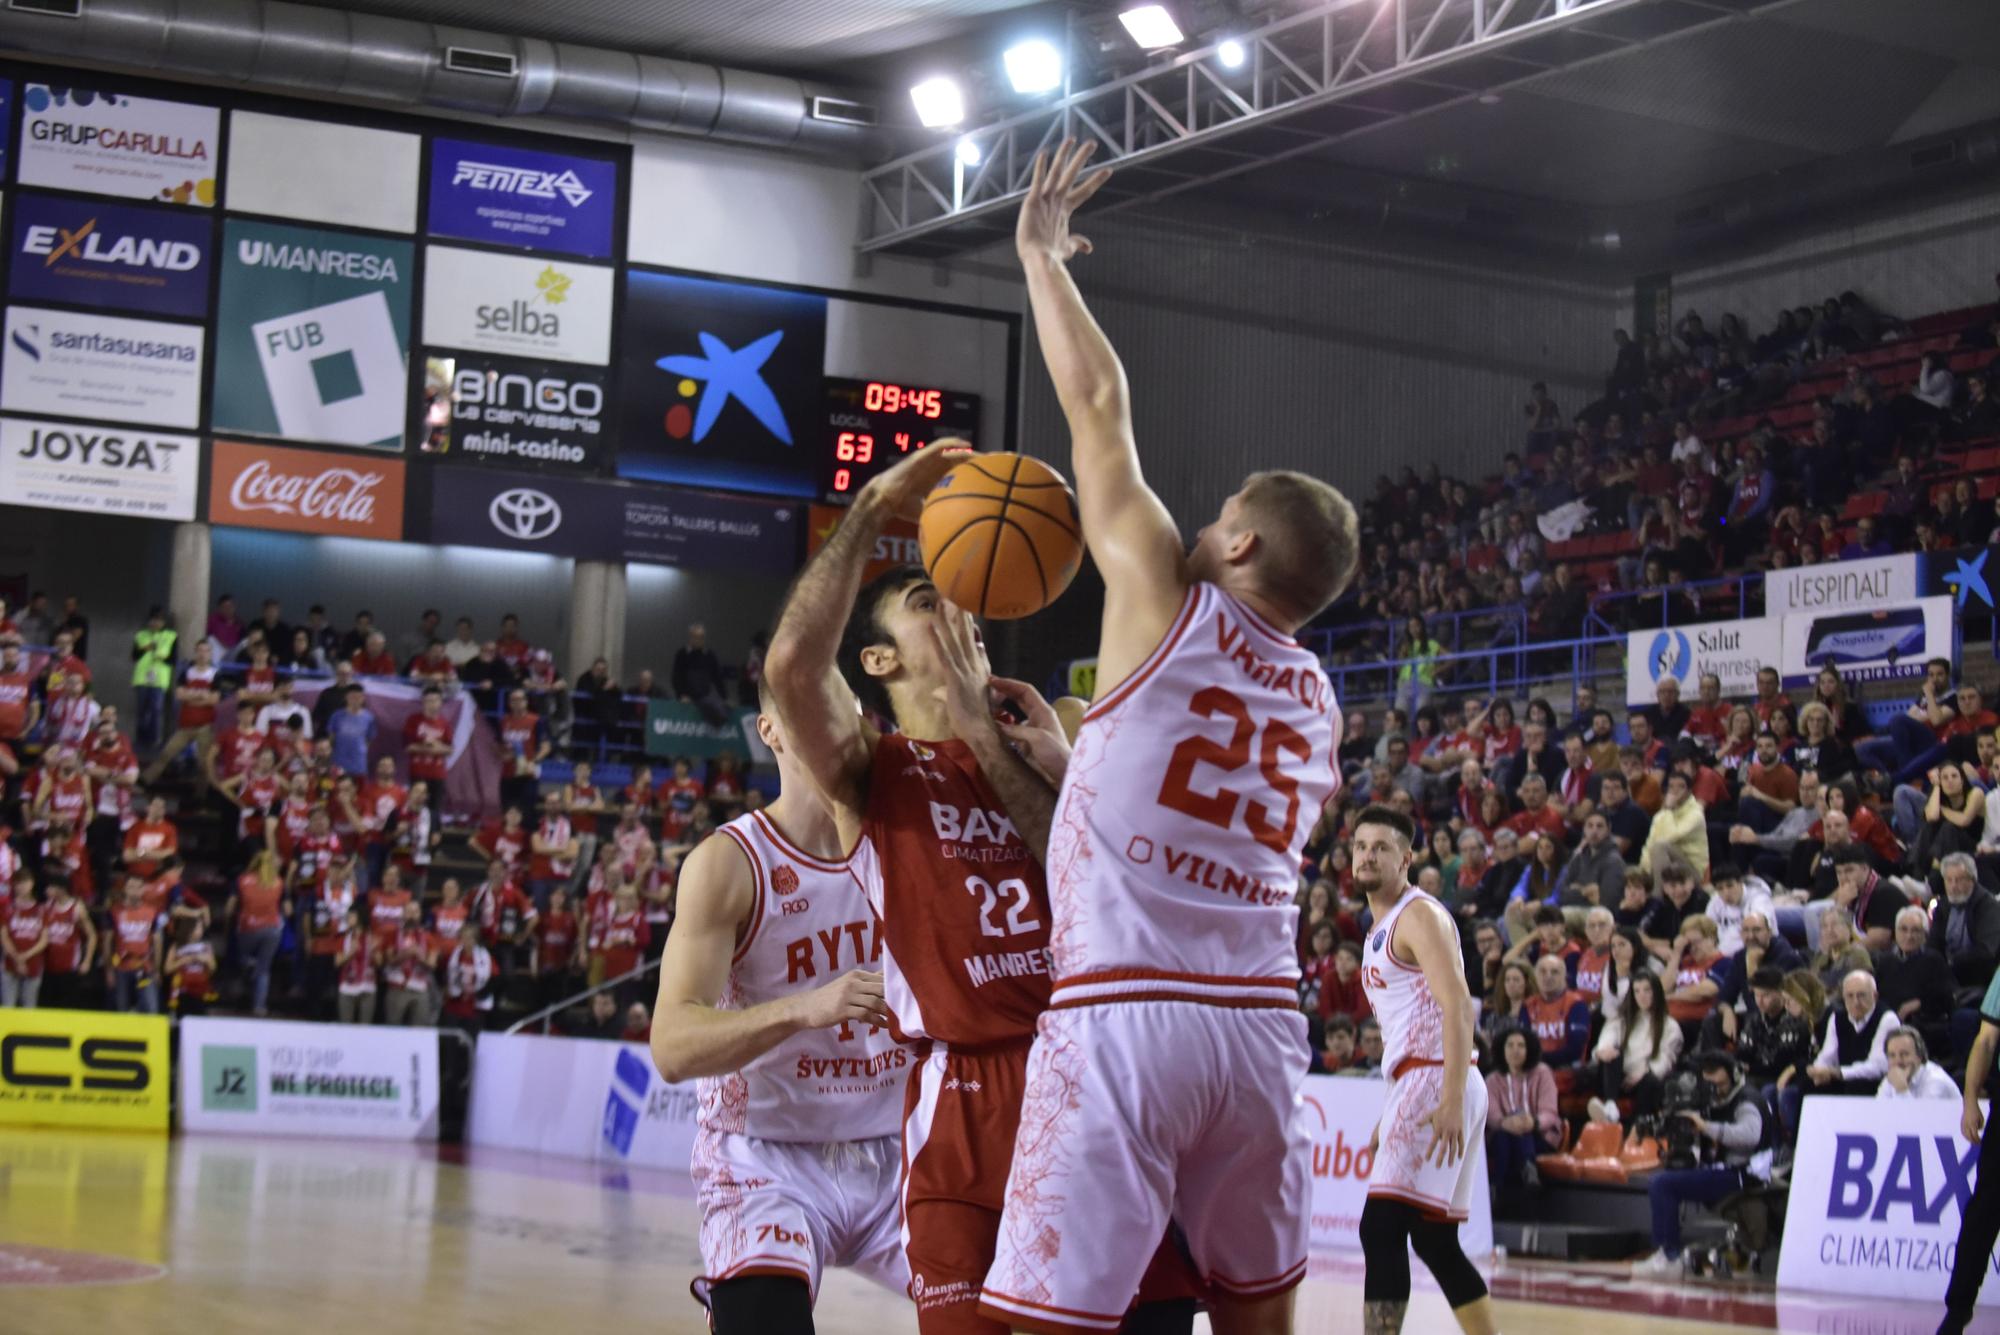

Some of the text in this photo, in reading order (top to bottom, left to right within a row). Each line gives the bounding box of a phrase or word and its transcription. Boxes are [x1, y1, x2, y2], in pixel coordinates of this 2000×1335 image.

[31, 119, 208, 161] GRUPCARULLA
[22, 217, 200, 271] EXLAND
[238, 239, 399, 284] UMANRESA
[475, 299, 560, 338] selba
[50, 329, 197, 363] santasusana
[267, 321, 324, 358] FUB
[864, 382, 942, 419] 09:45
[18, 428, 181, 474] JOYSAT
[463, 430, 585, 465] mini-casino
[836, 431, 874, 464] 63
[894, 431, 910, 453] 4
[834, 468, 850, 492] 0
[1698, 629, 1740, 654] Salut
[1156, 686, 1312, 854] 25
[965, 875, 1040, 938] 22
